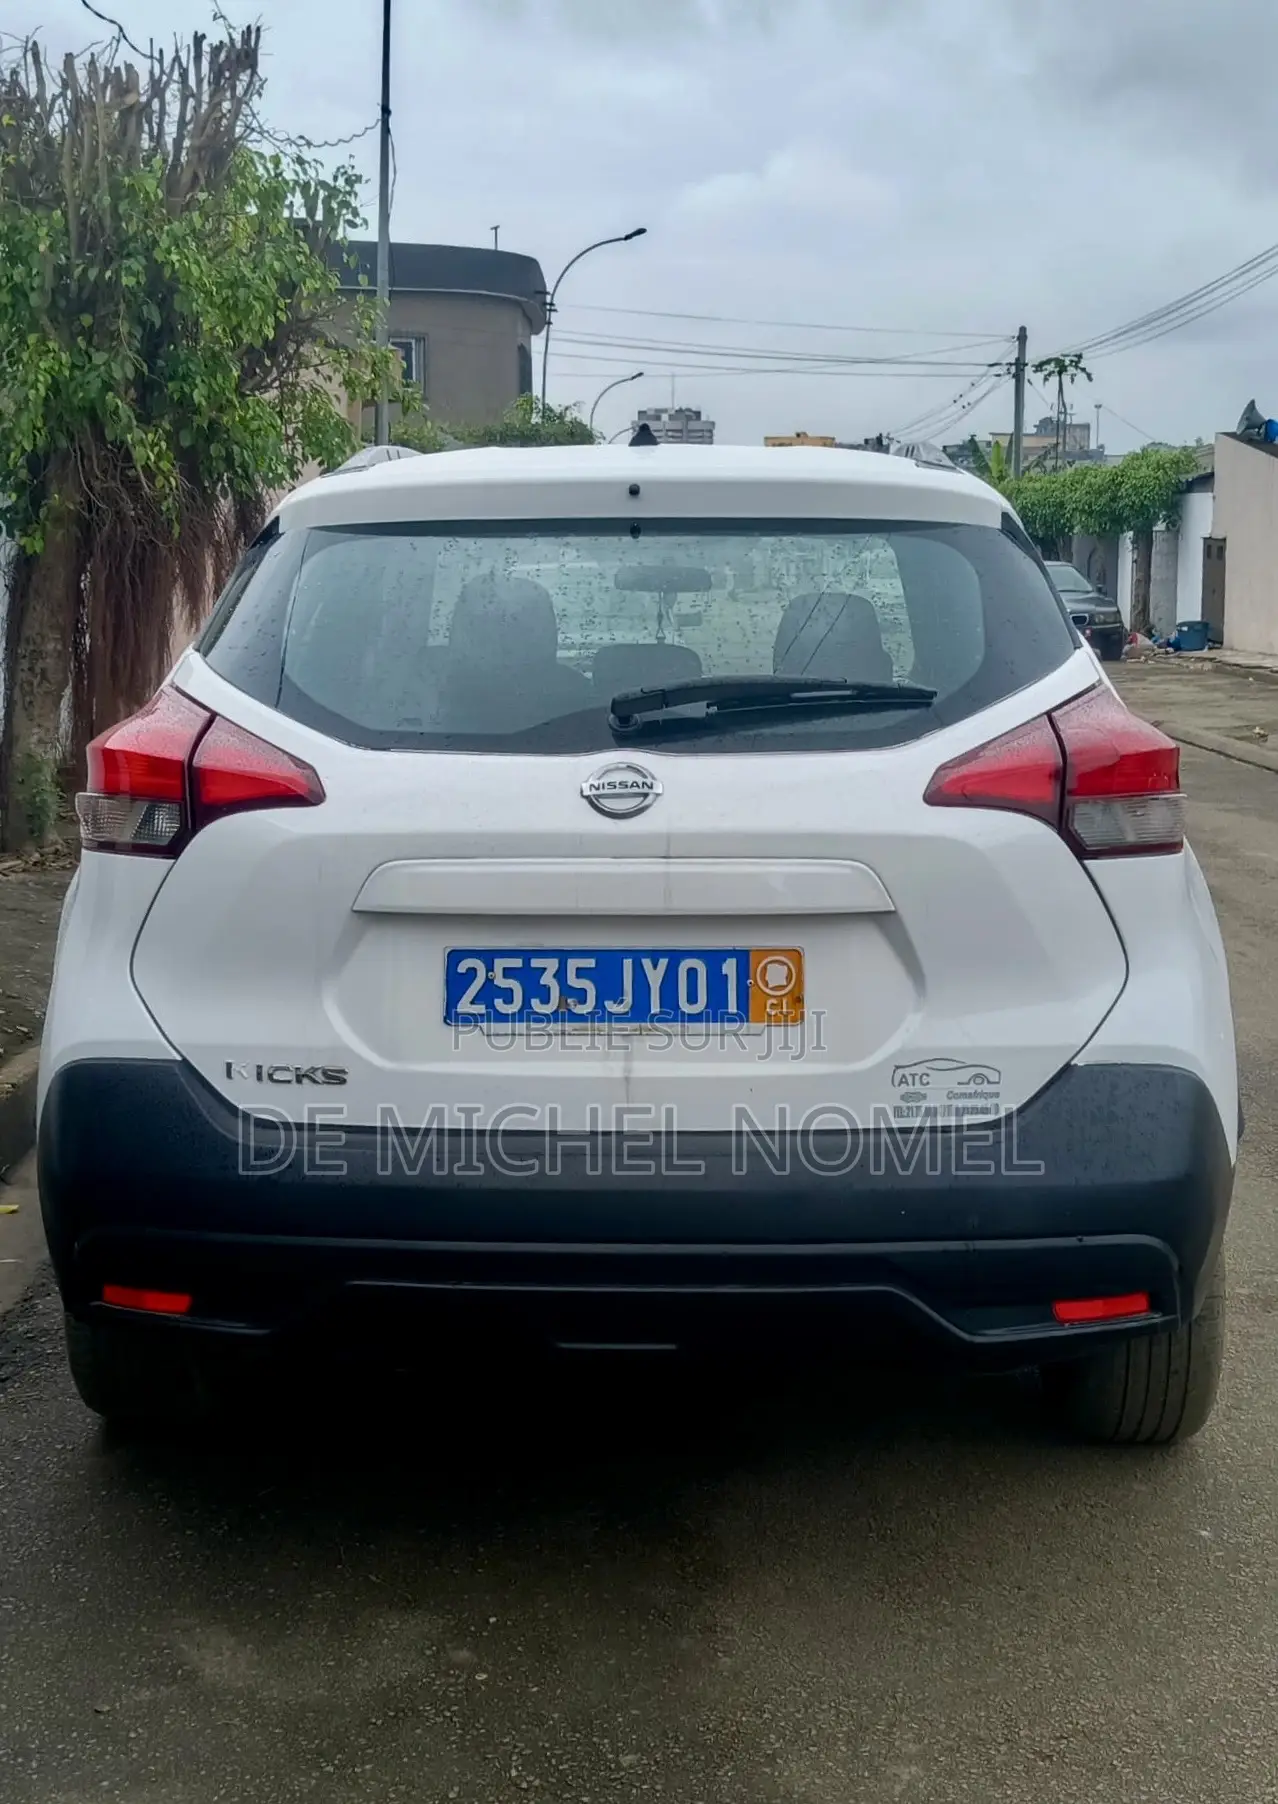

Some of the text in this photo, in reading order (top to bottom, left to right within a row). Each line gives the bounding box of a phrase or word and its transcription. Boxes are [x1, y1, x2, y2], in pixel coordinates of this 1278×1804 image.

[589, 781, 654, 792] NISSAN
[225, 1060, 348, 1085] KICKS
[898, 1073, 930, 1086] ATC
